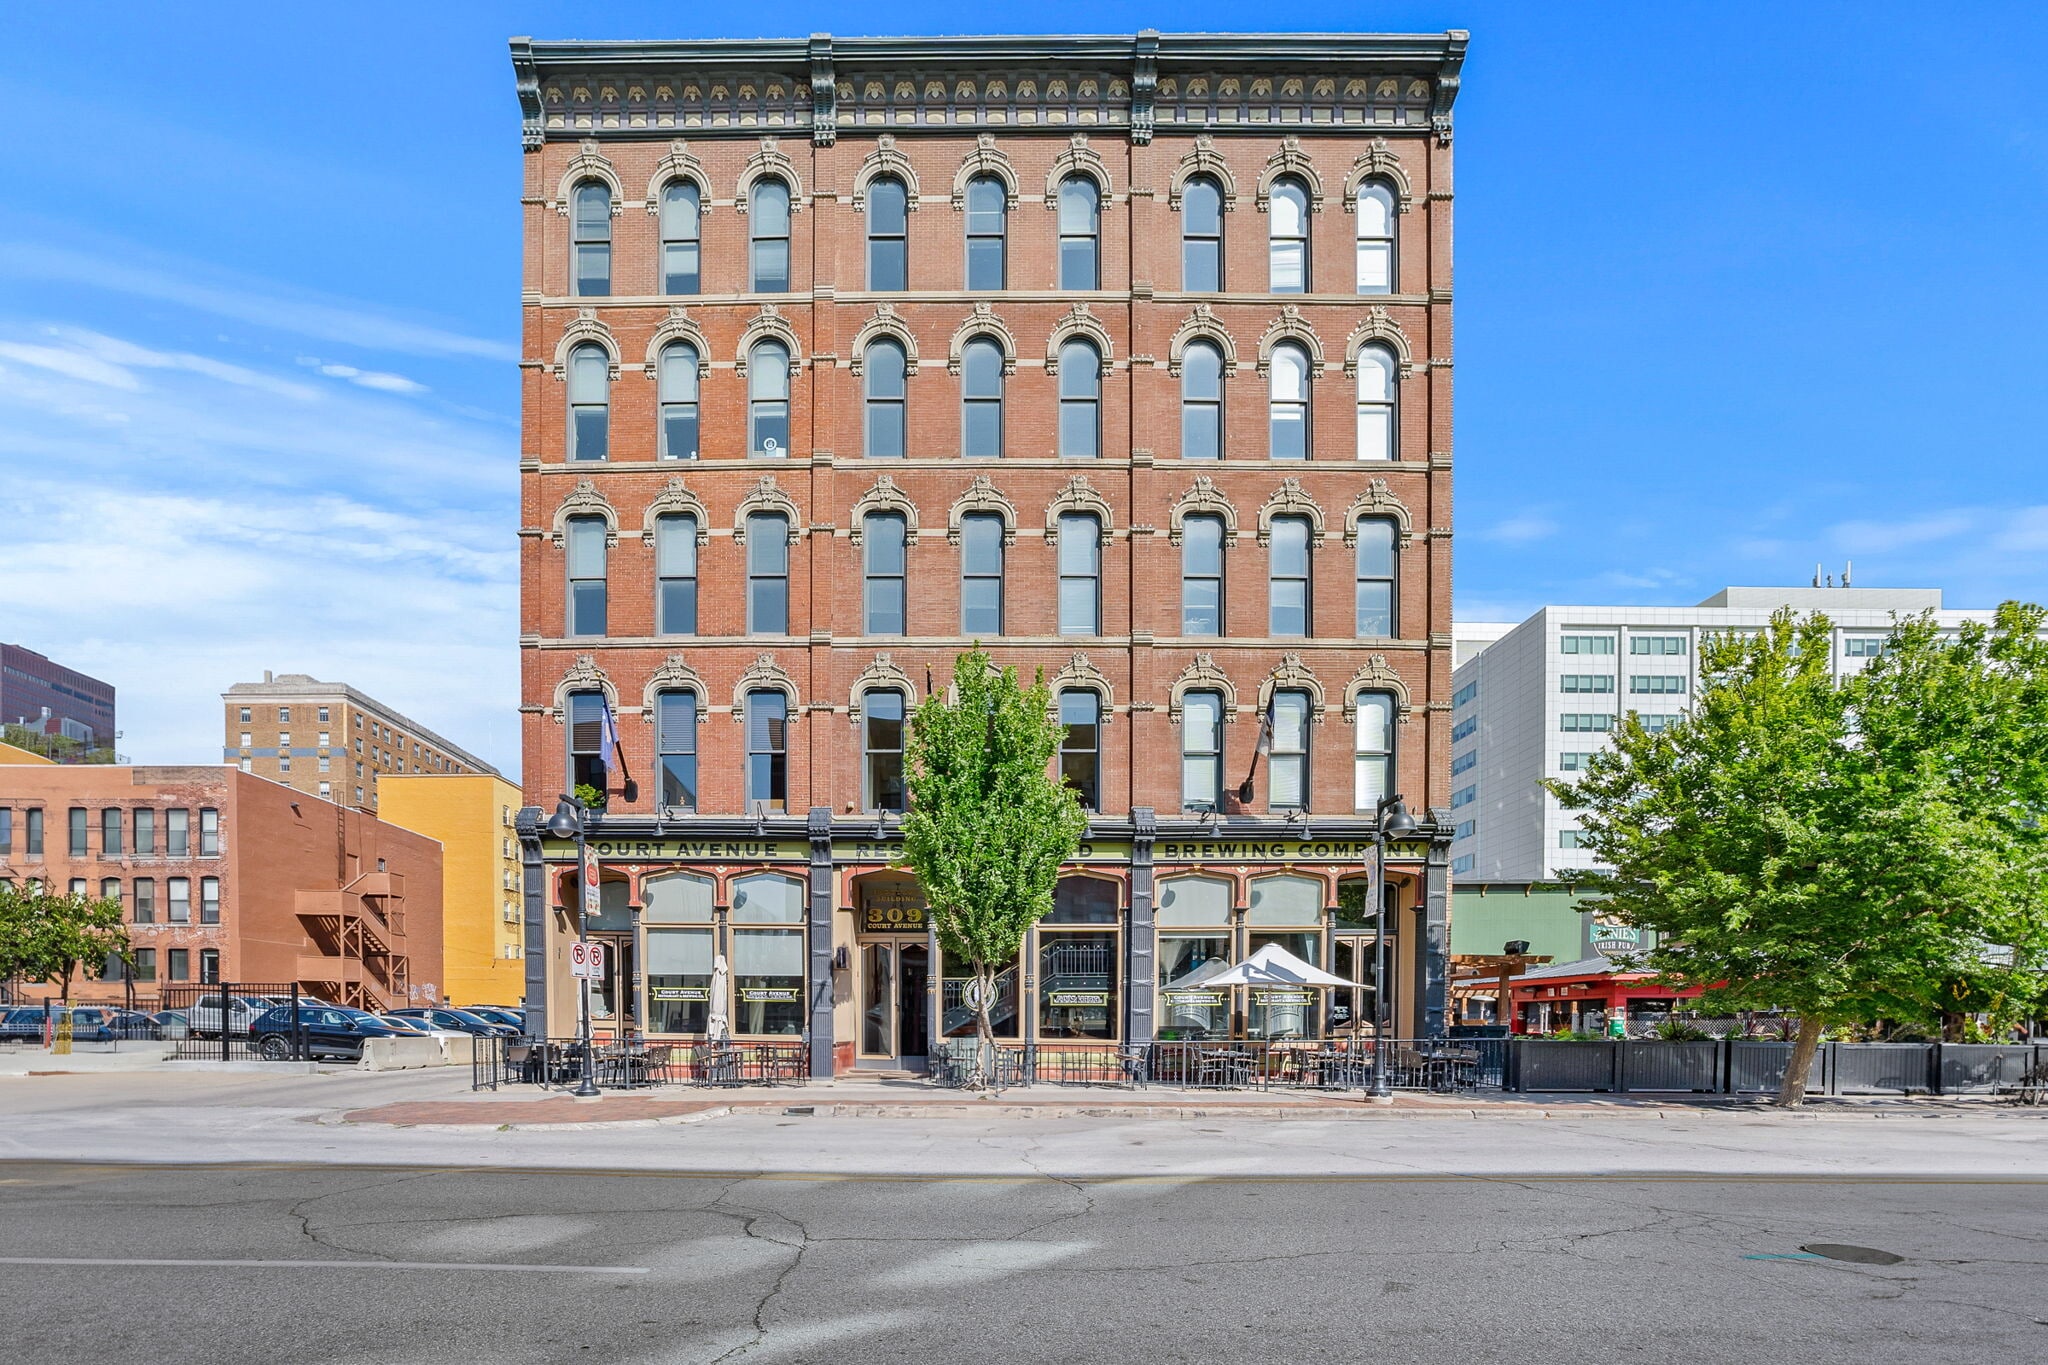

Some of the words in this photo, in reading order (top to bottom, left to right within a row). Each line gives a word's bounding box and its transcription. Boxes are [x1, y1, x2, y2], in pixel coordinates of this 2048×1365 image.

[676, 843, 778, 857] AVENUE
[1164, 844, 1286, 858] BREWING
[1298, 843, 1419, 858] COMPNY
[868, 908, 922, 923] 309
[1598, 941, 1616, 949] IRISH
[1618, 941, 1631, 949] PUB
